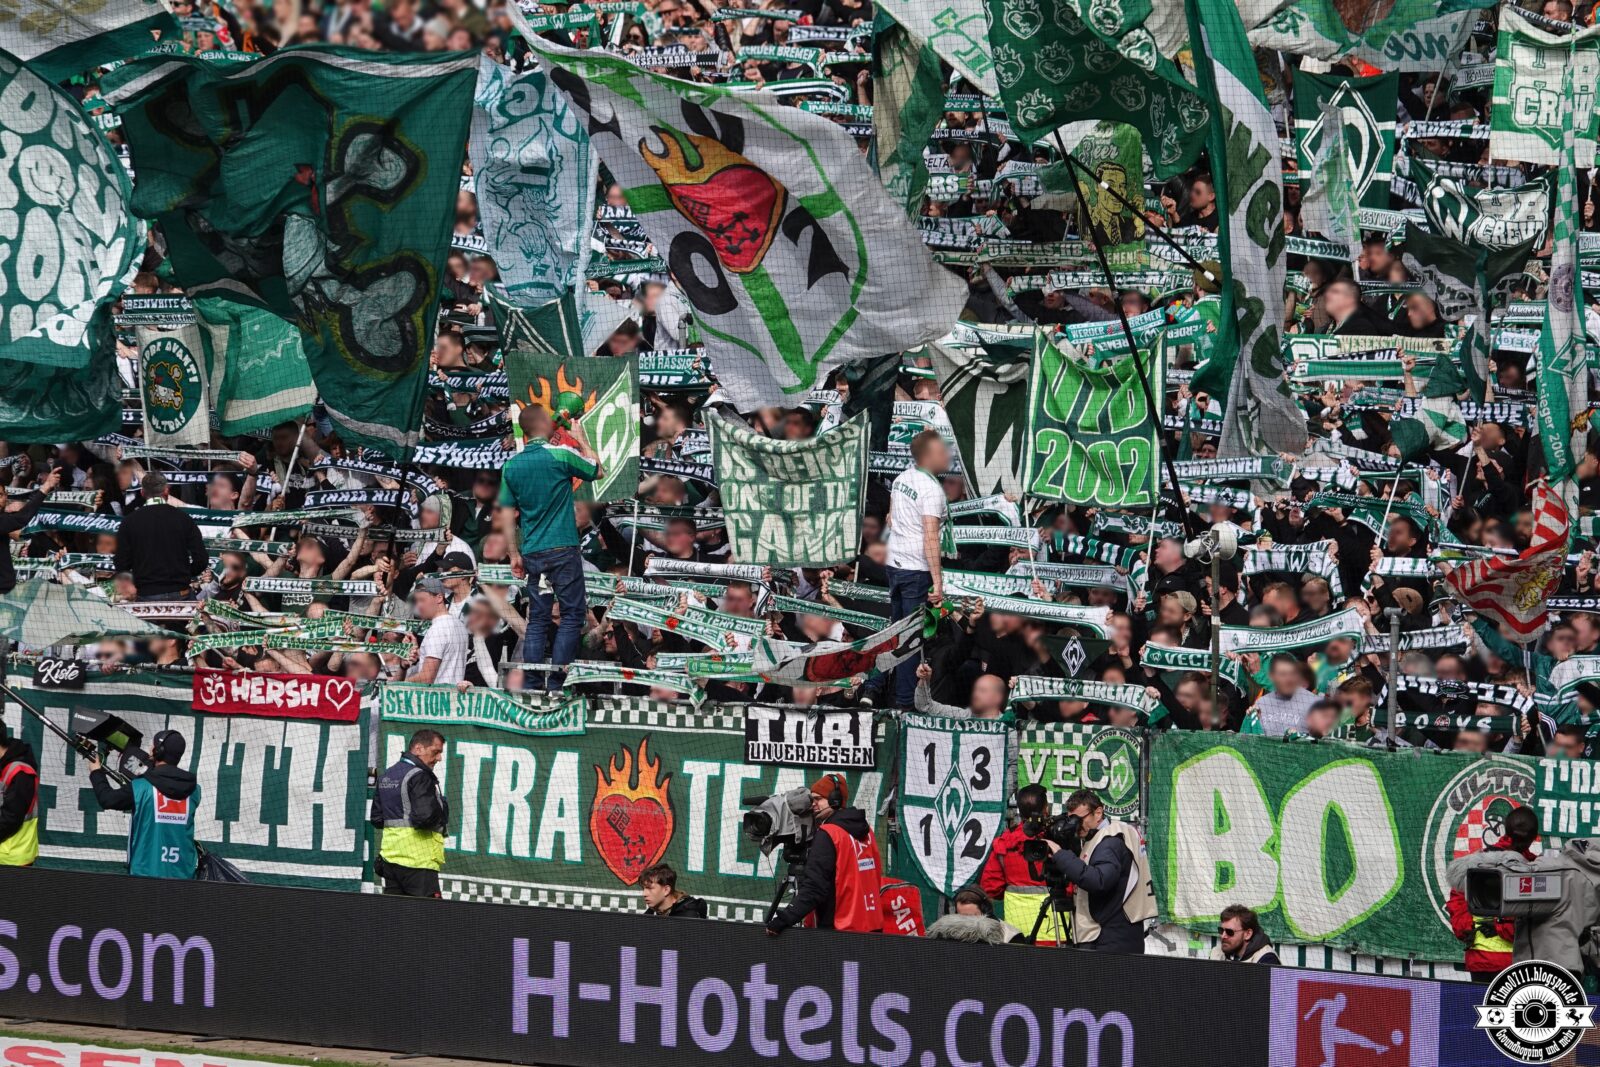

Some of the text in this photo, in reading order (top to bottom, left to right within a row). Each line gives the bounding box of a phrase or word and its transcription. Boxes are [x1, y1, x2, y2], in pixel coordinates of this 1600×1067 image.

[632, 53, 697, 68] ESERSTADION
[776, 47, 816, 60] BREMEN
[1513, 88, 1594, 133] CRW
[1474, 215, 1545, 248] CREW
[1070, 311, 1162, 340] WERDER BREMEN
[657, 357, 693, 371] RASSIS
[150, 410, 187, 433] ULTRAS
[719, 443, 756, 481] IS
[1032, 426, 1150, 507] 2002
[720, 482, 776, 511] ONE
[783, 482, 816, 511] OF
[64, 513, 121, 538] antifasc
[724, 509, 857, 564] GANG!
[1245, 634, 1260, 646] 125
[1259, 632, 1286, 646] JAHRE
[1296, 622, 1331, 641] WERDER
[38, 659, 79, 684] Kiste
[230, 678, 320, 709] HERSH
[385, 690, 452, 718] SEKTION
[747, 708, 875, 752] TOBI
[904, 715, 1008, 734] NIQUE LA POLICE
[748, 741, 874, 770] UNVERGESSEN
[923, 742, 992, 790] 1 3
[1446, 767, 1538, 816] ULTR
[919, 813, 987, 859] 1 2
[161, 846, 180, 863] 25
[511, 936, 1136, 1067] H-Hotels.com
